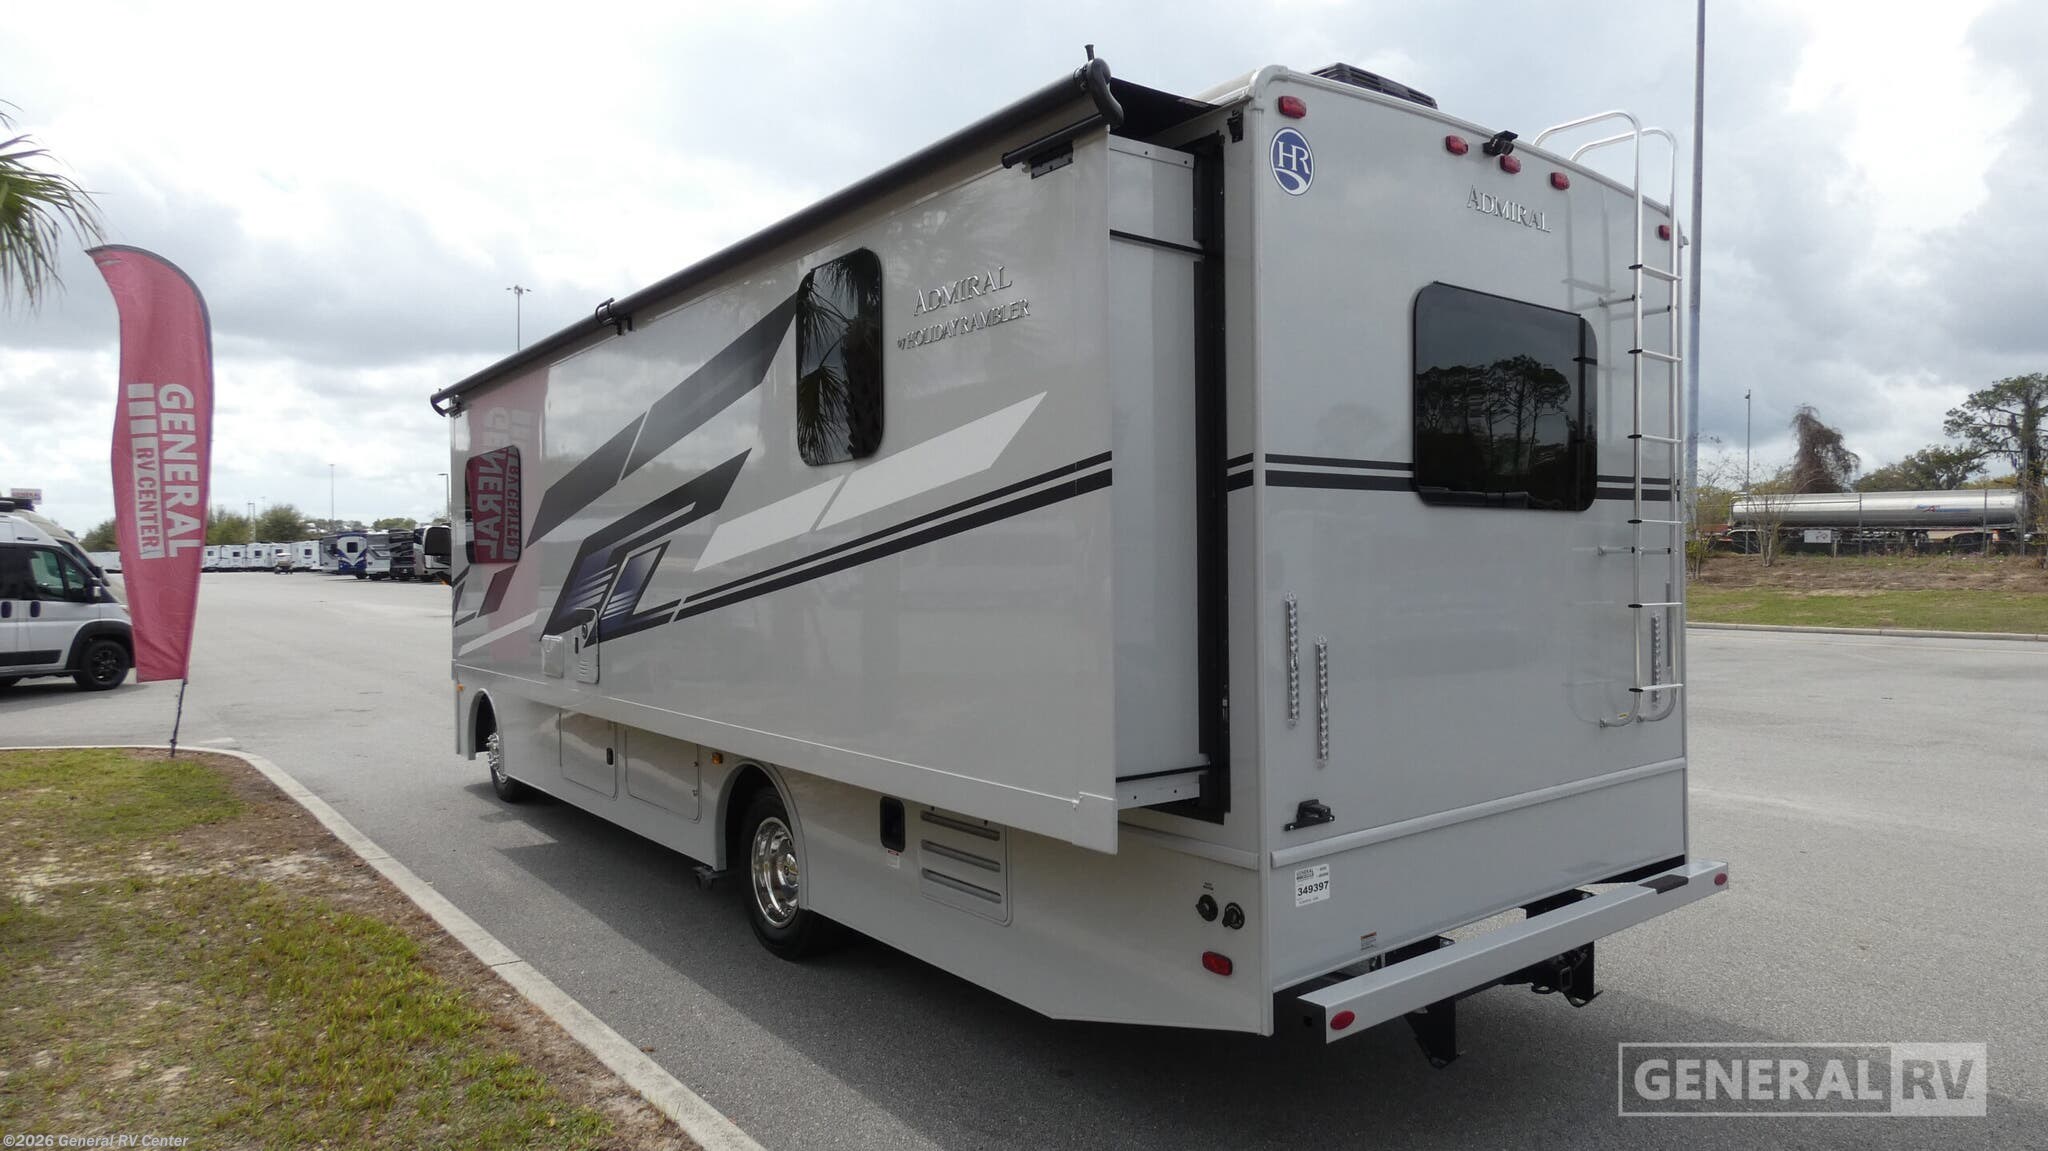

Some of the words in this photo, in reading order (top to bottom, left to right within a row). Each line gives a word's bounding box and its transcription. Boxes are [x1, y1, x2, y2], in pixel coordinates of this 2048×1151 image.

[1277, 141, 1311, 174] HR
[1466, 185, 1552, 233] ADMIRAL
[913, 264, 1014, 317] ADMIRAL
[135, 447, 156, 472] RV
[159, 383, 201, 558] GENERAL
[137, 476, 160, 549] CENTER
[1297, 880, 1329, 897] 349397
